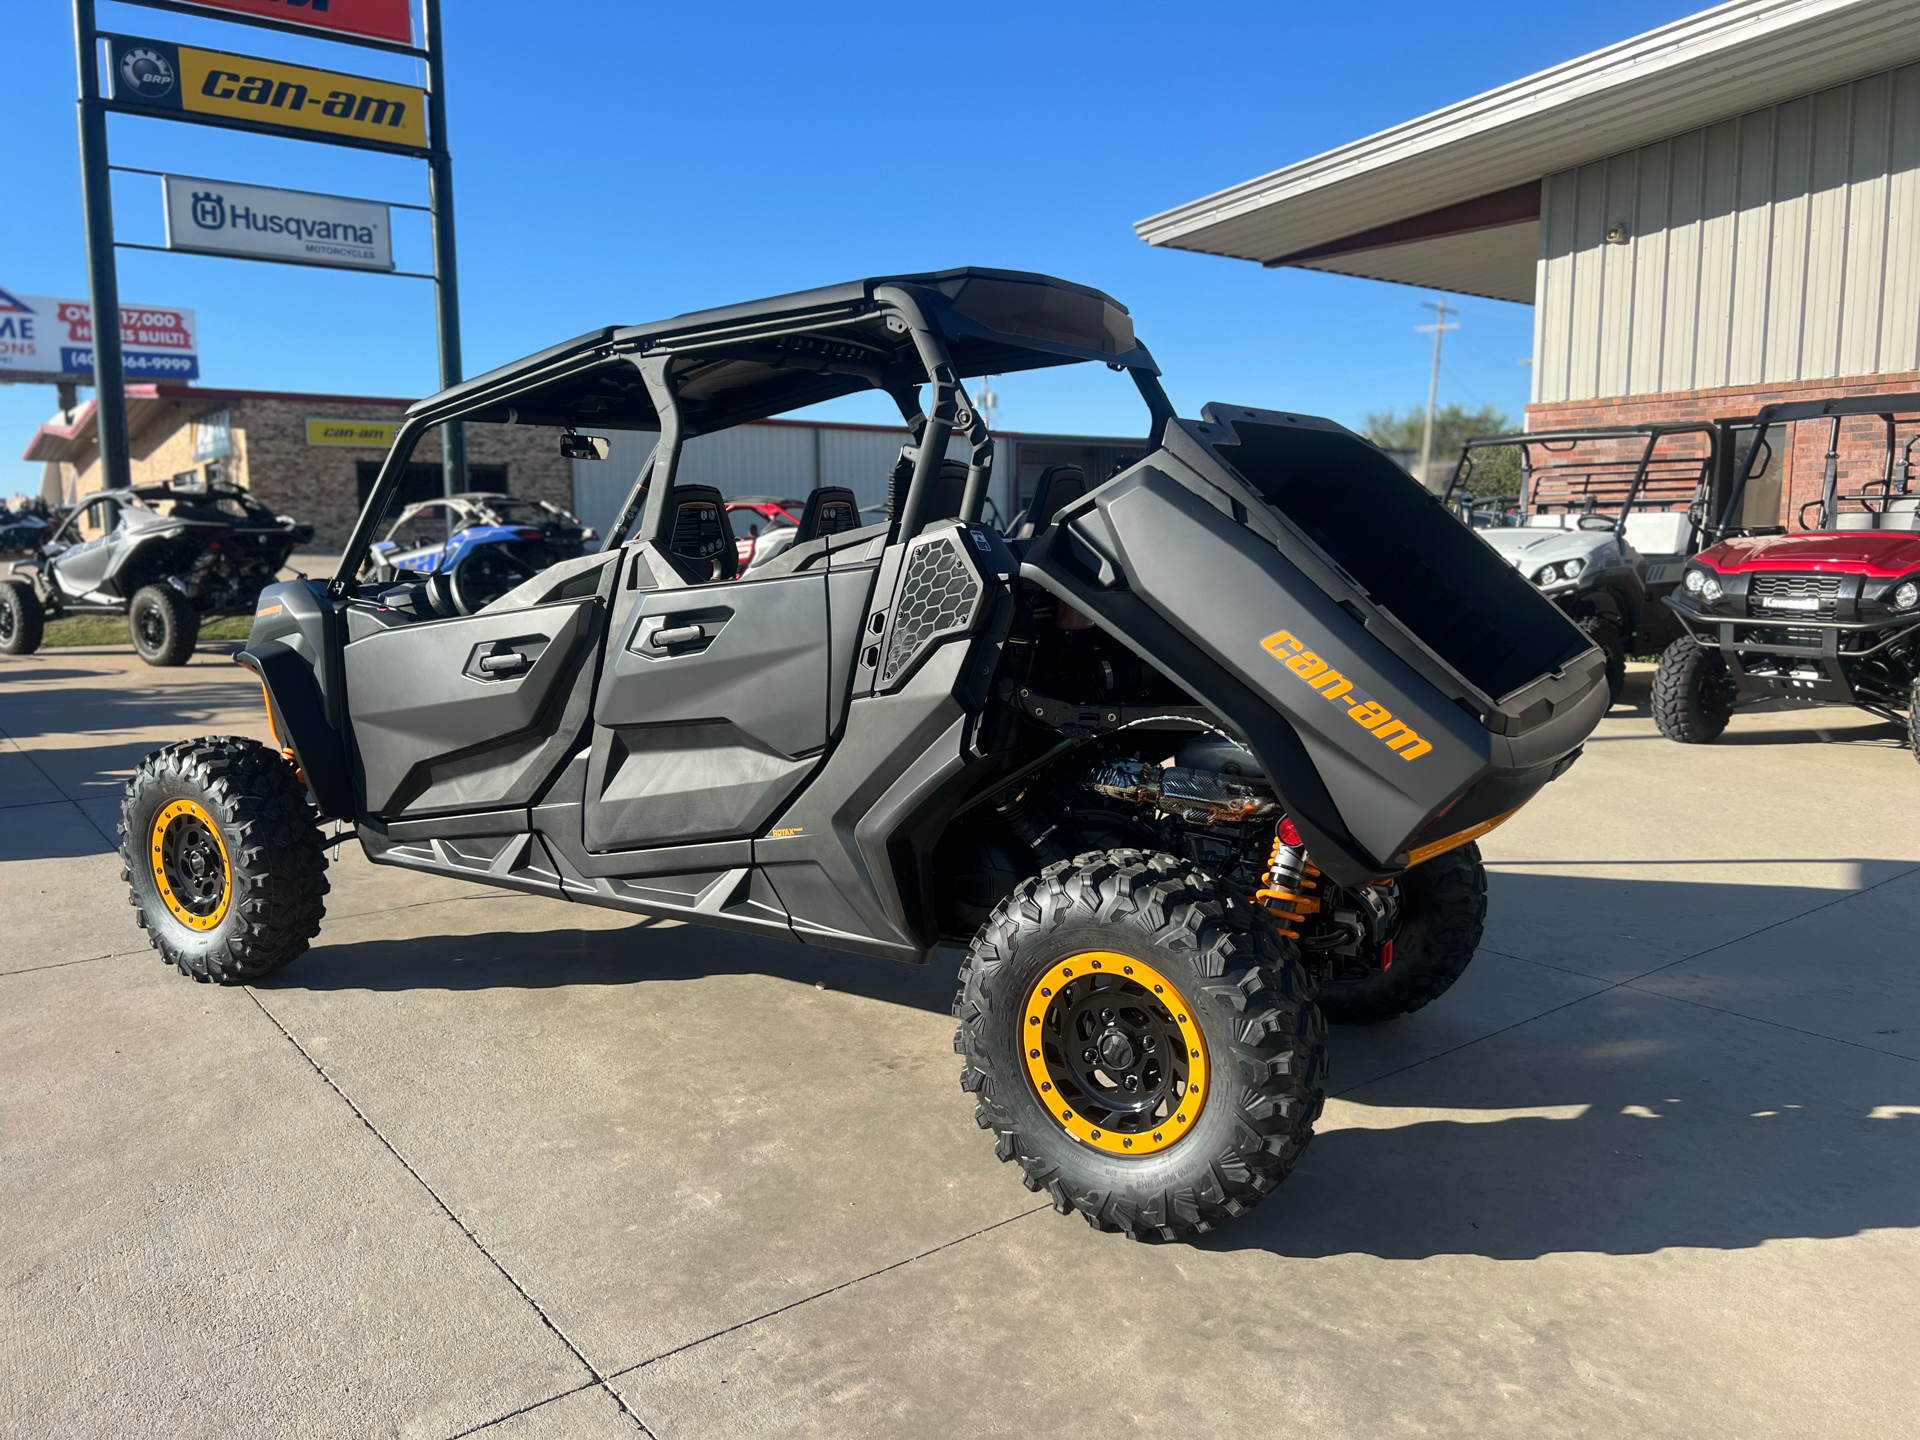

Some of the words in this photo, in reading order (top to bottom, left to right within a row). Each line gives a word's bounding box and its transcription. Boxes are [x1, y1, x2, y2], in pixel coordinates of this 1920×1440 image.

[142, 73, 171, 84] BRP
[201, 70, 406, 127] can-am
[230, 204, 374, 244] Husqvarna
[305, 244, 375, 259] MOTORCYCLES
[119, 311, 176, 328] 17,000
[138, 329, 184, 345] BUILT!
[323, 426, 385, 439] can-am
[1762, 597, 1819, 610] Kawasaki
[1260, 629, 1433, 762] can-am
[772, 828, 795, 837] ROTAX
